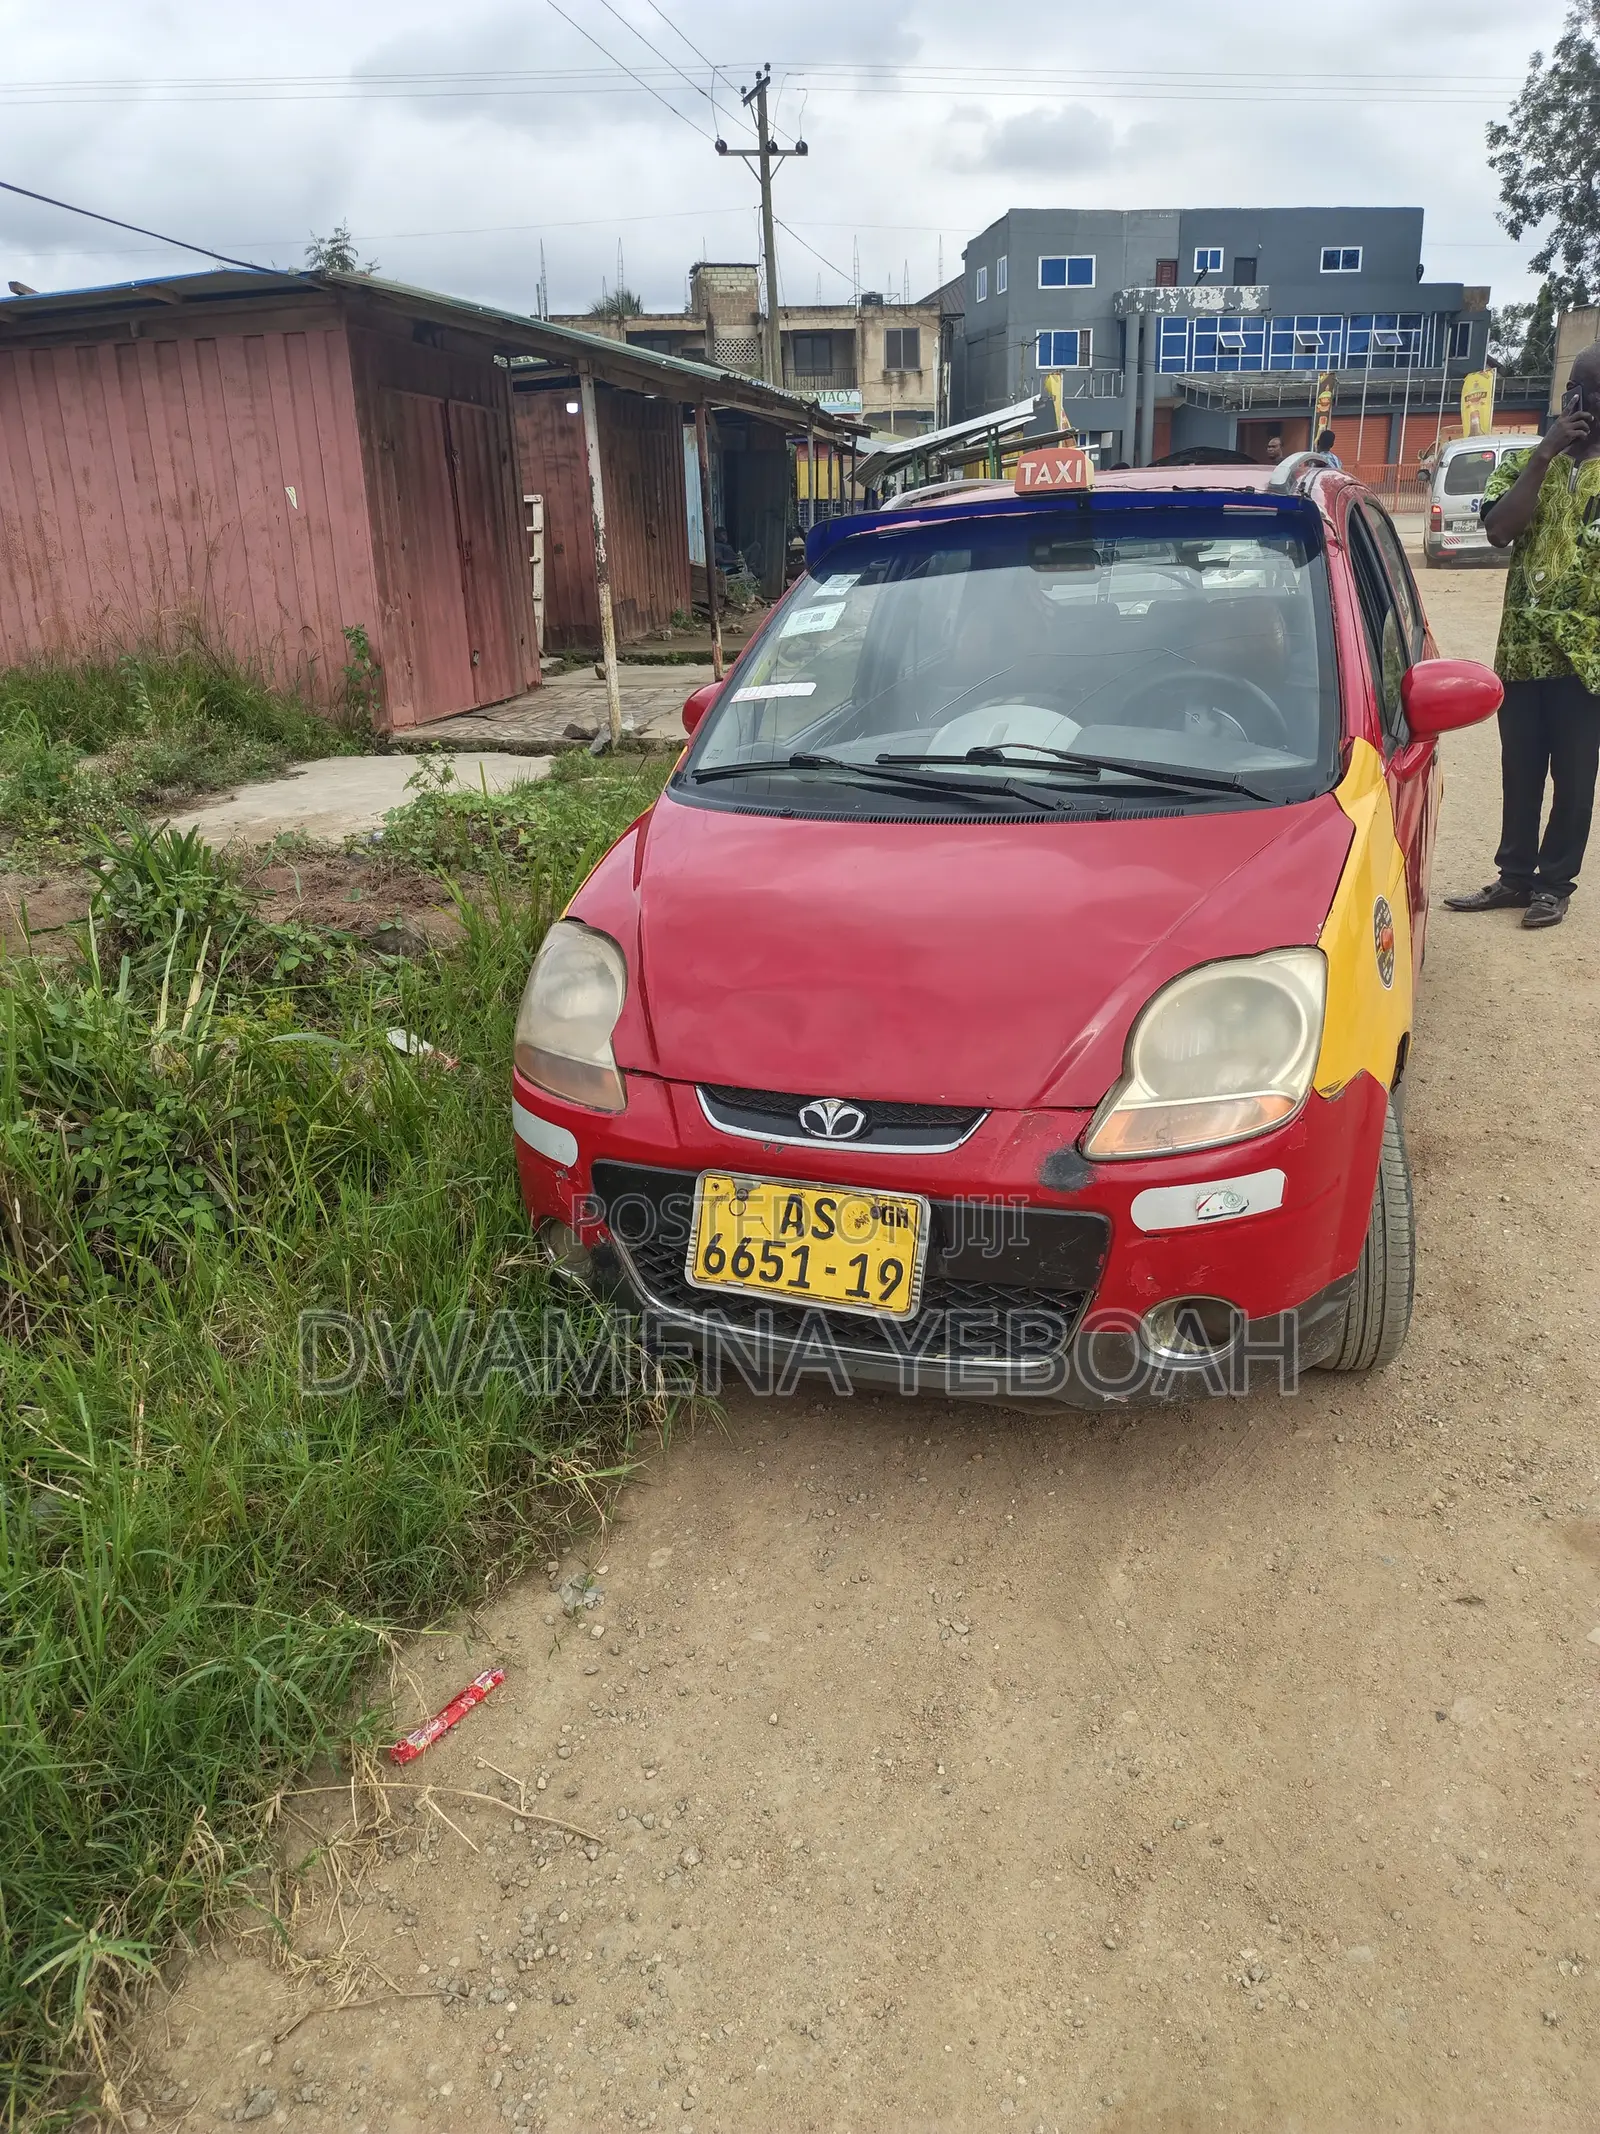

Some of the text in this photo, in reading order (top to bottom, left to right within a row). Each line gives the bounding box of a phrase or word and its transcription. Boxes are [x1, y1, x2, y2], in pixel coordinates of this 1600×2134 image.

[1020, 459, 1083, 486] TAXI
[780, 1194, 909, 1239] AS GH
[702, 1232, 905, 1302] 6651-19
